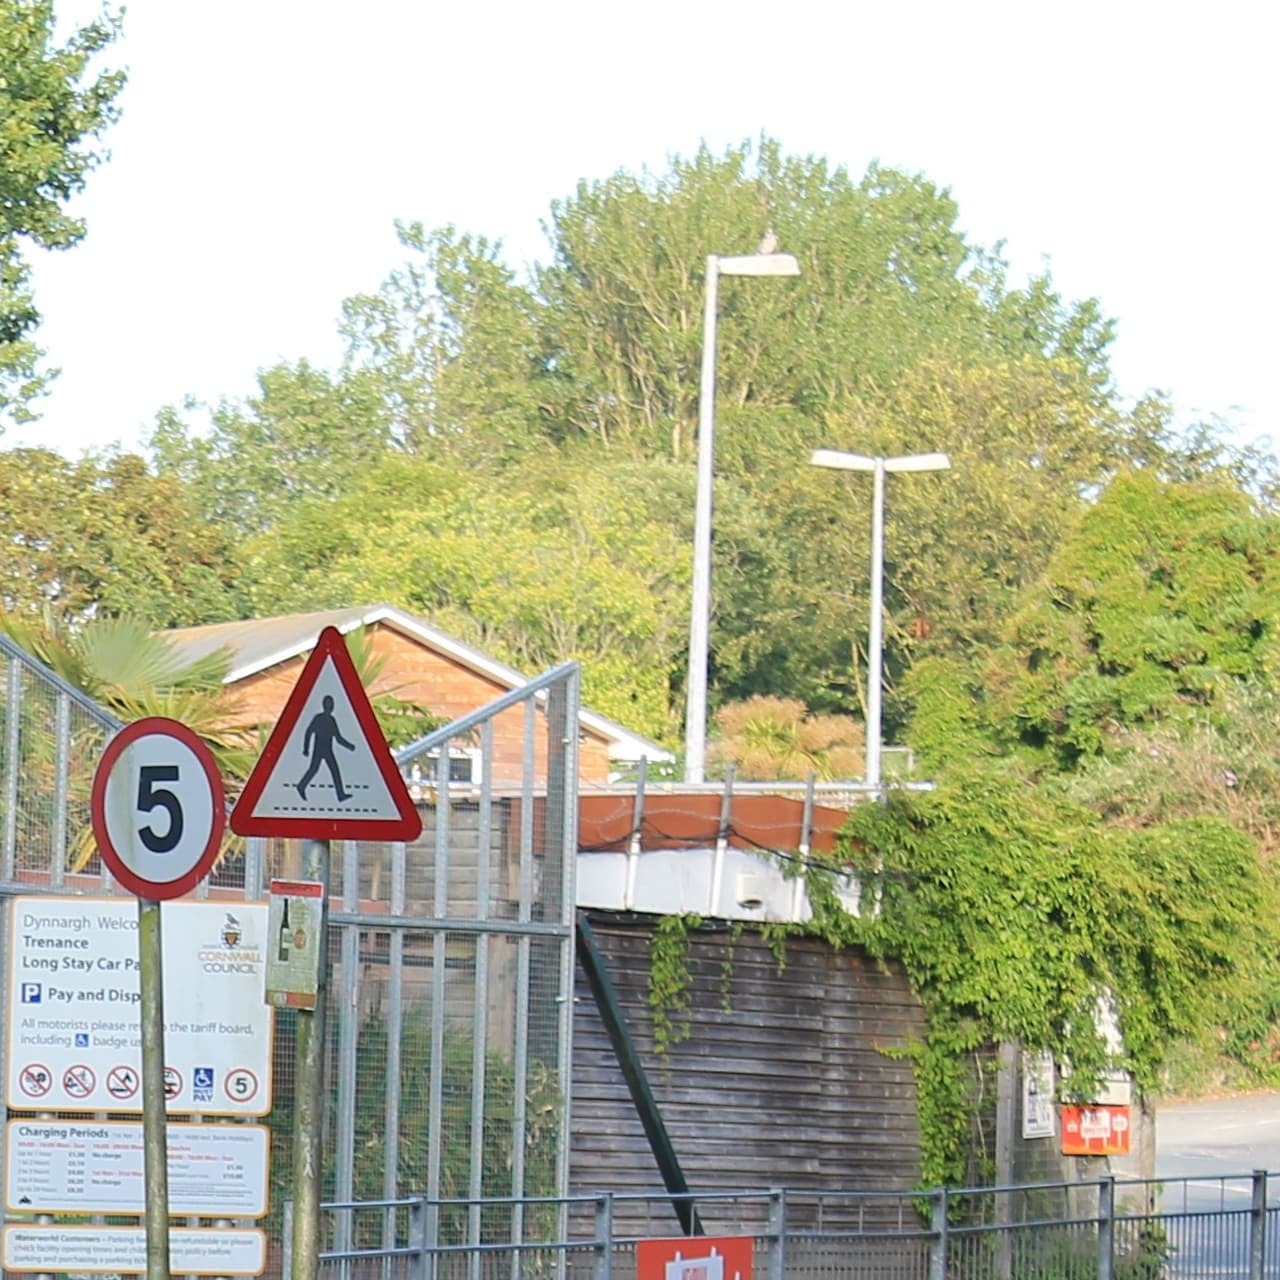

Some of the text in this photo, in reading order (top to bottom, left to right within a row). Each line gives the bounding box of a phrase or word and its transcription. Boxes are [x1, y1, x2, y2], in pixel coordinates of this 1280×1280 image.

[137, 765, 184, 854] 5
[23, 914, 140, 932] Dynnargh Welco
[23, 935, 89, 949] Trenance
[22, 956, 141, 972] Long Stay Car Pa
[197, 951, 264, 963] CORNWALL
[203, 963, 257, 974] COUNCIL
[48, 987, 142, 1005] Pay and Disp
[21, 1018, 36, 1029] All
[37, 1018, 89, 1030] motorists
[91, 1019, 126, 1033] please
[169, 1022, 189, 1033] the
[191, 1022, 217, 1033] tariff
[20, 1033, 72, 1048] including
[92, 1035, 129, 1050] badge
[235, 1077, 248, 1094] 5
[194, 1094, 213, 1102] PAY
[18, 1126, 68, 1139] Charging
[69, 1127, 109, 1139] Periods
